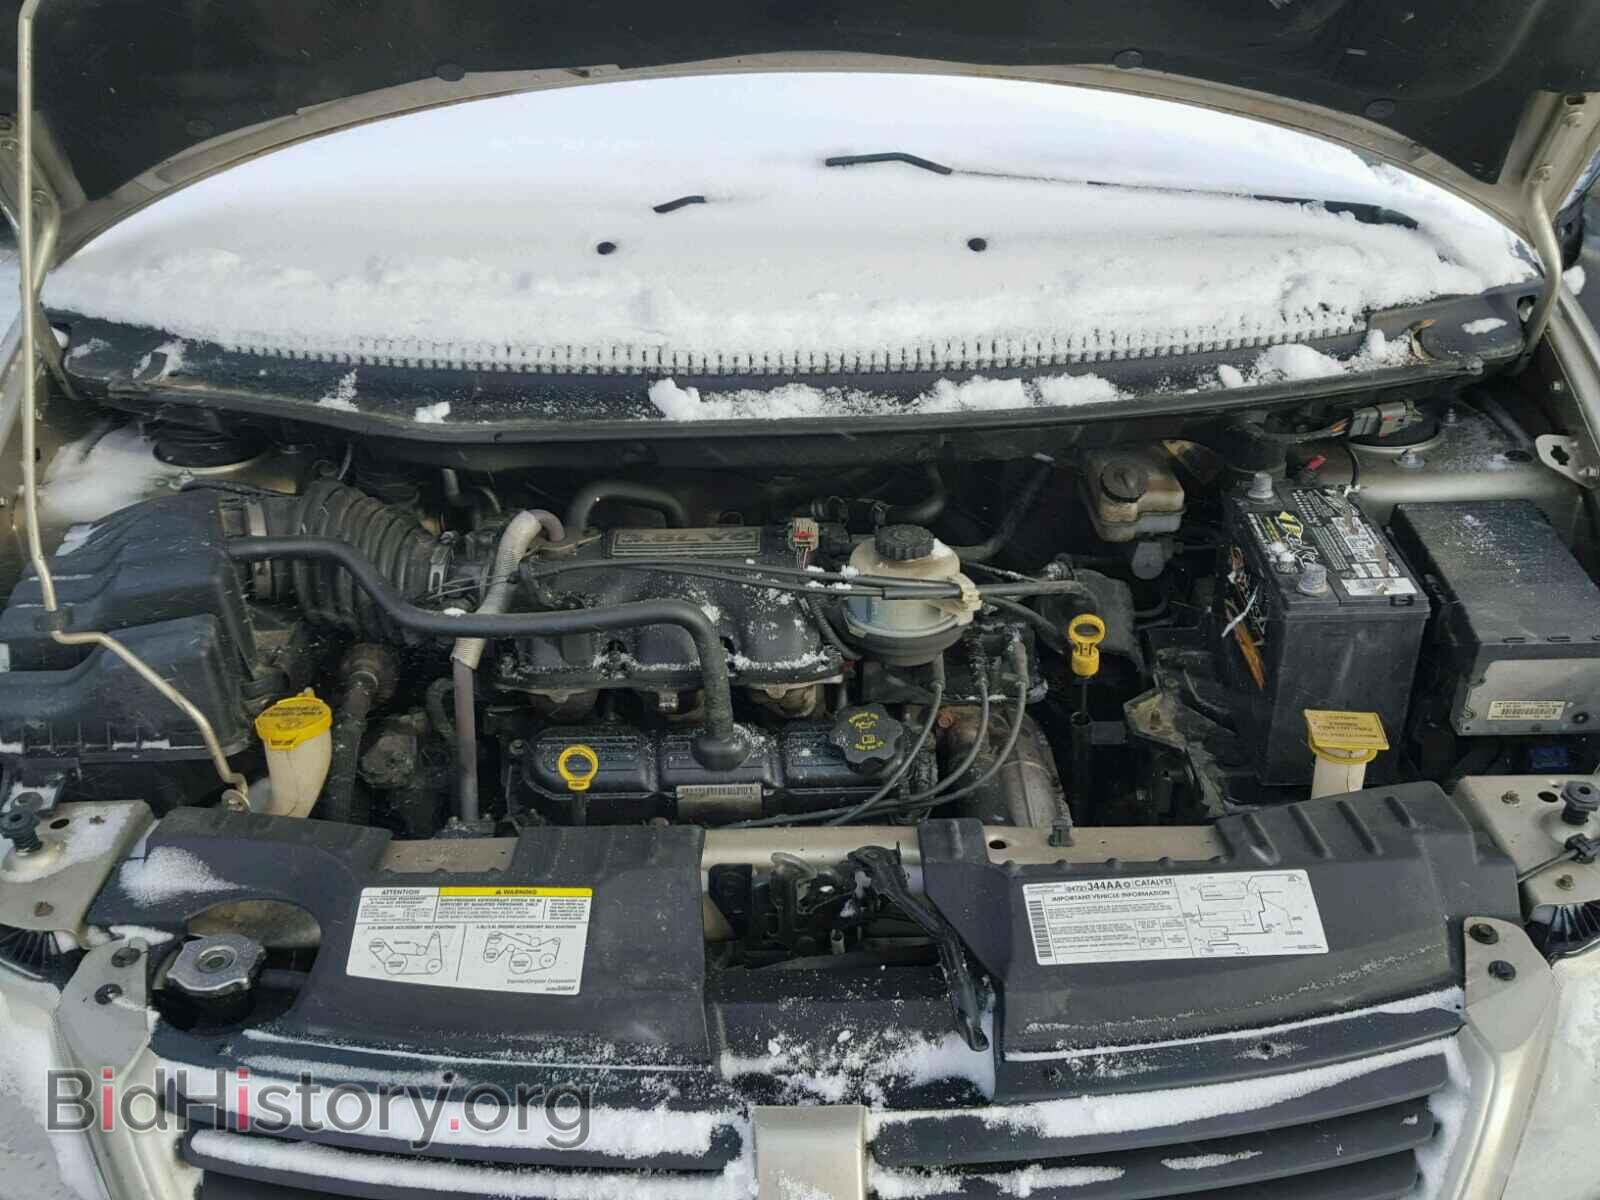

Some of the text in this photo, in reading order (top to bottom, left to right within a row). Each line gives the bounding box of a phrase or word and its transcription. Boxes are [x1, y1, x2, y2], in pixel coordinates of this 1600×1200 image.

[1134, 878, 1173, 888] CATALYST
[382, 888, 421, 896] ATTENTION
[1052, 890, 1171, 902] IMPORTANT VEHICLE INFORMATION
